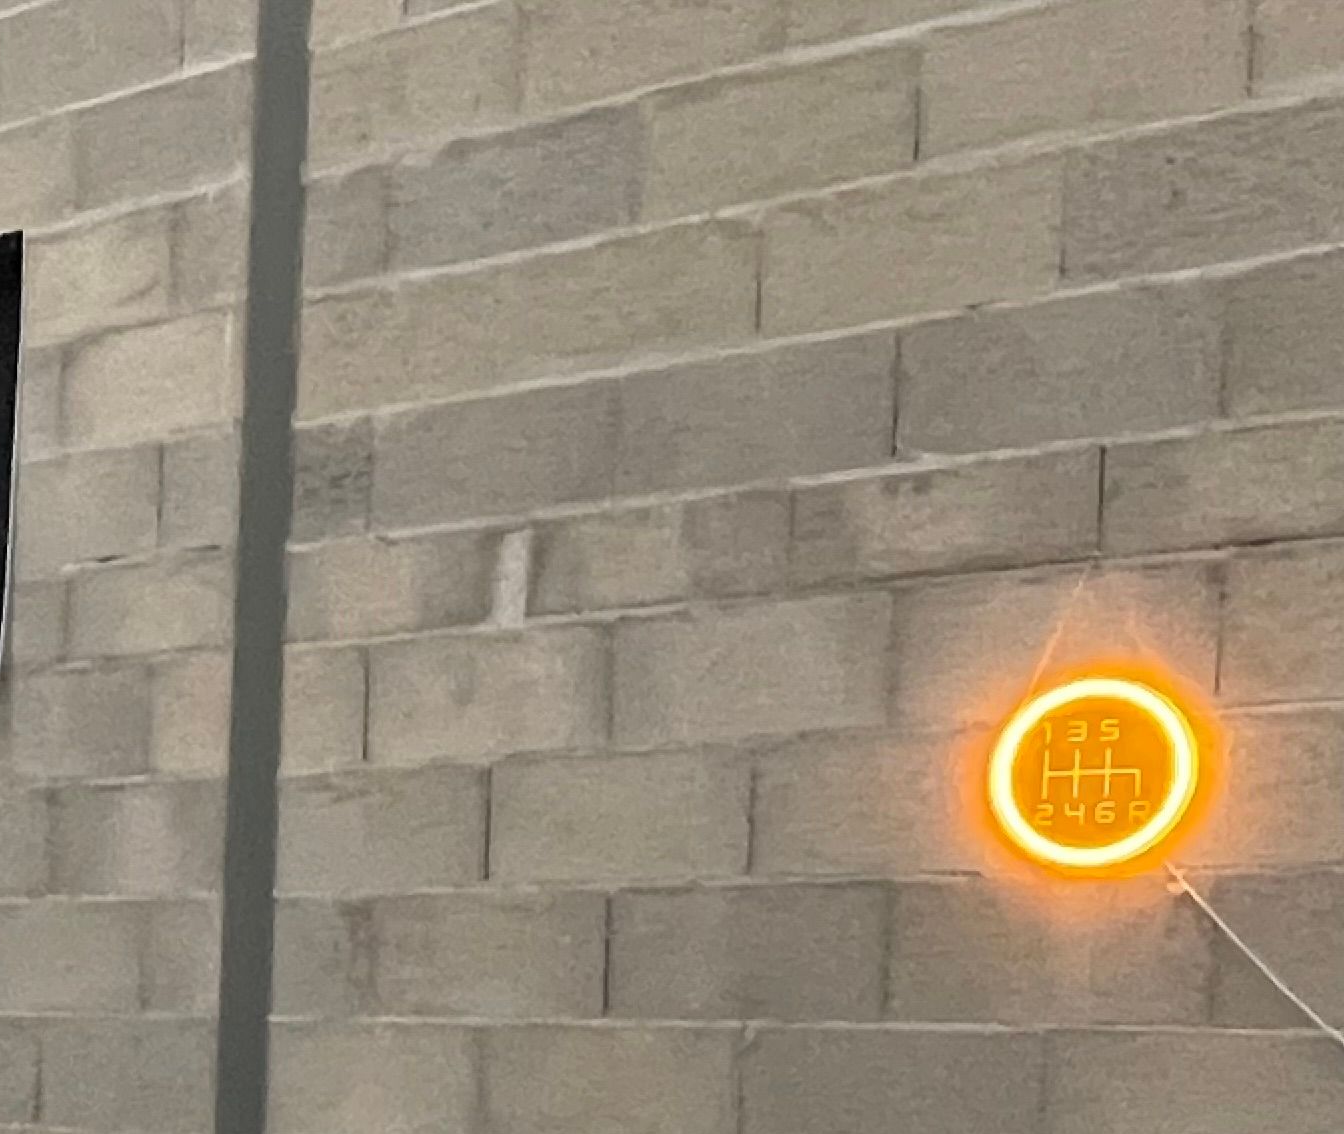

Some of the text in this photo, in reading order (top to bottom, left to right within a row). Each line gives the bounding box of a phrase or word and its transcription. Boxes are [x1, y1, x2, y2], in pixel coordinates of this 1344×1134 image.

[1067, 720, 1088, 742] 3
[1099, 718, 1120, 741] 5
[1035, 803, 1054, 826] 2
[1064, 803, 1085, 825] 4
[1094, 801, 1116, 824] 6
